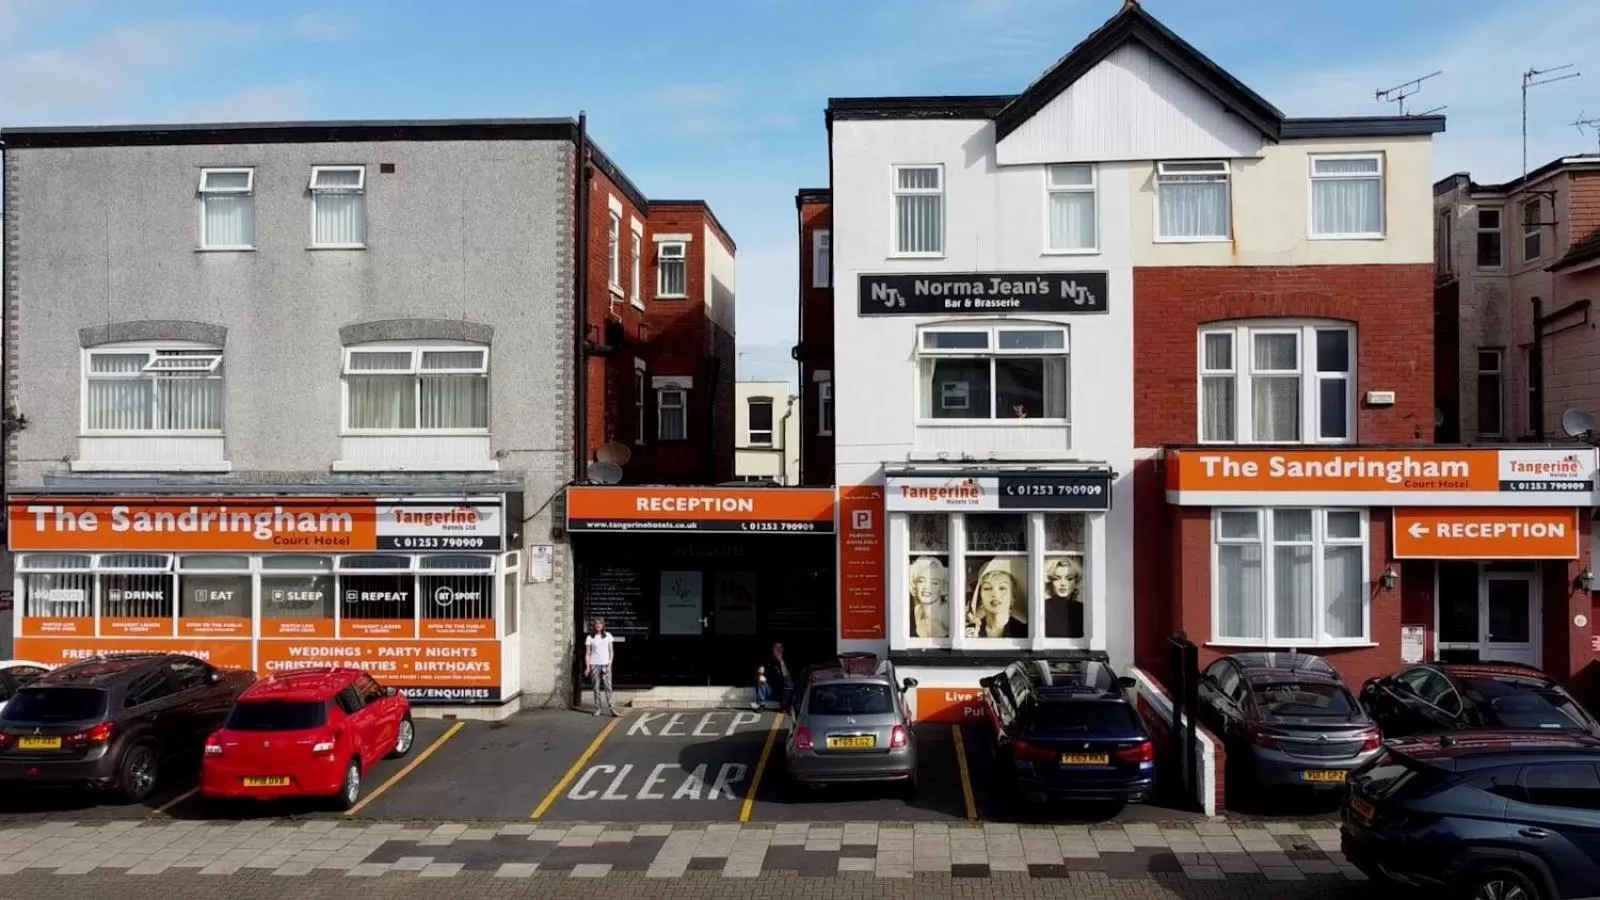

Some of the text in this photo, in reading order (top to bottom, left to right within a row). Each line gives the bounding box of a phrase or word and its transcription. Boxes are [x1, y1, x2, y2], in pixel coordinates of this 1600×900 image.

[915, 277, 1049, 296] Norma Jean's
[944, 298, 1020, 308] Bar & Brasserie
[1200, 455, 1469, 484] The Sandringham
[1510, 460, 1578, 474] Tangerine
[1404, 479, 1469, 489] Court Hotel
[1518, 482, 1585, 490] 01253 790909
[900, 485, 979, 501] Tangerine
[1017, 485, 1102, 495] 01253 790909
[636, 497, 753, 512] RECEPTION
[27, 504, 353, 540] The Sandringham
[394, 509, 476, 526] Tangerine
[586, 520, 698, 530] www.tangerinehotels.co.uk
[749, 522, 814, 531] 01253 790909
[1437, 523, 1565, 538] RECEPTION
[273, 535, 350, 546] Court Hotel
[404, 538, 484, 547] 01253 790909
[124, 591, 164, 600] DRINK
[210, 591, 234, 600] EAT
[287, 591, 323, 601] SLEEP
[361, 592, 408, 601] REPEAT
[454, 592, 480, 601] SPORT
[62, 649, 93, 659] FREE
[288, 647, 478, 657] WEDDINGS PARTY NIGHTS
[265, 660, 490, 671] CHRISTMAS PARTIES BIRTHDAYS
[398, 689, 489, 698] NGS/ENQUIRIES
[944, 691, 973, 701] Live
[626, 712, 762, 736] KEEP
[567, 763, 748, 800] CLEAR
